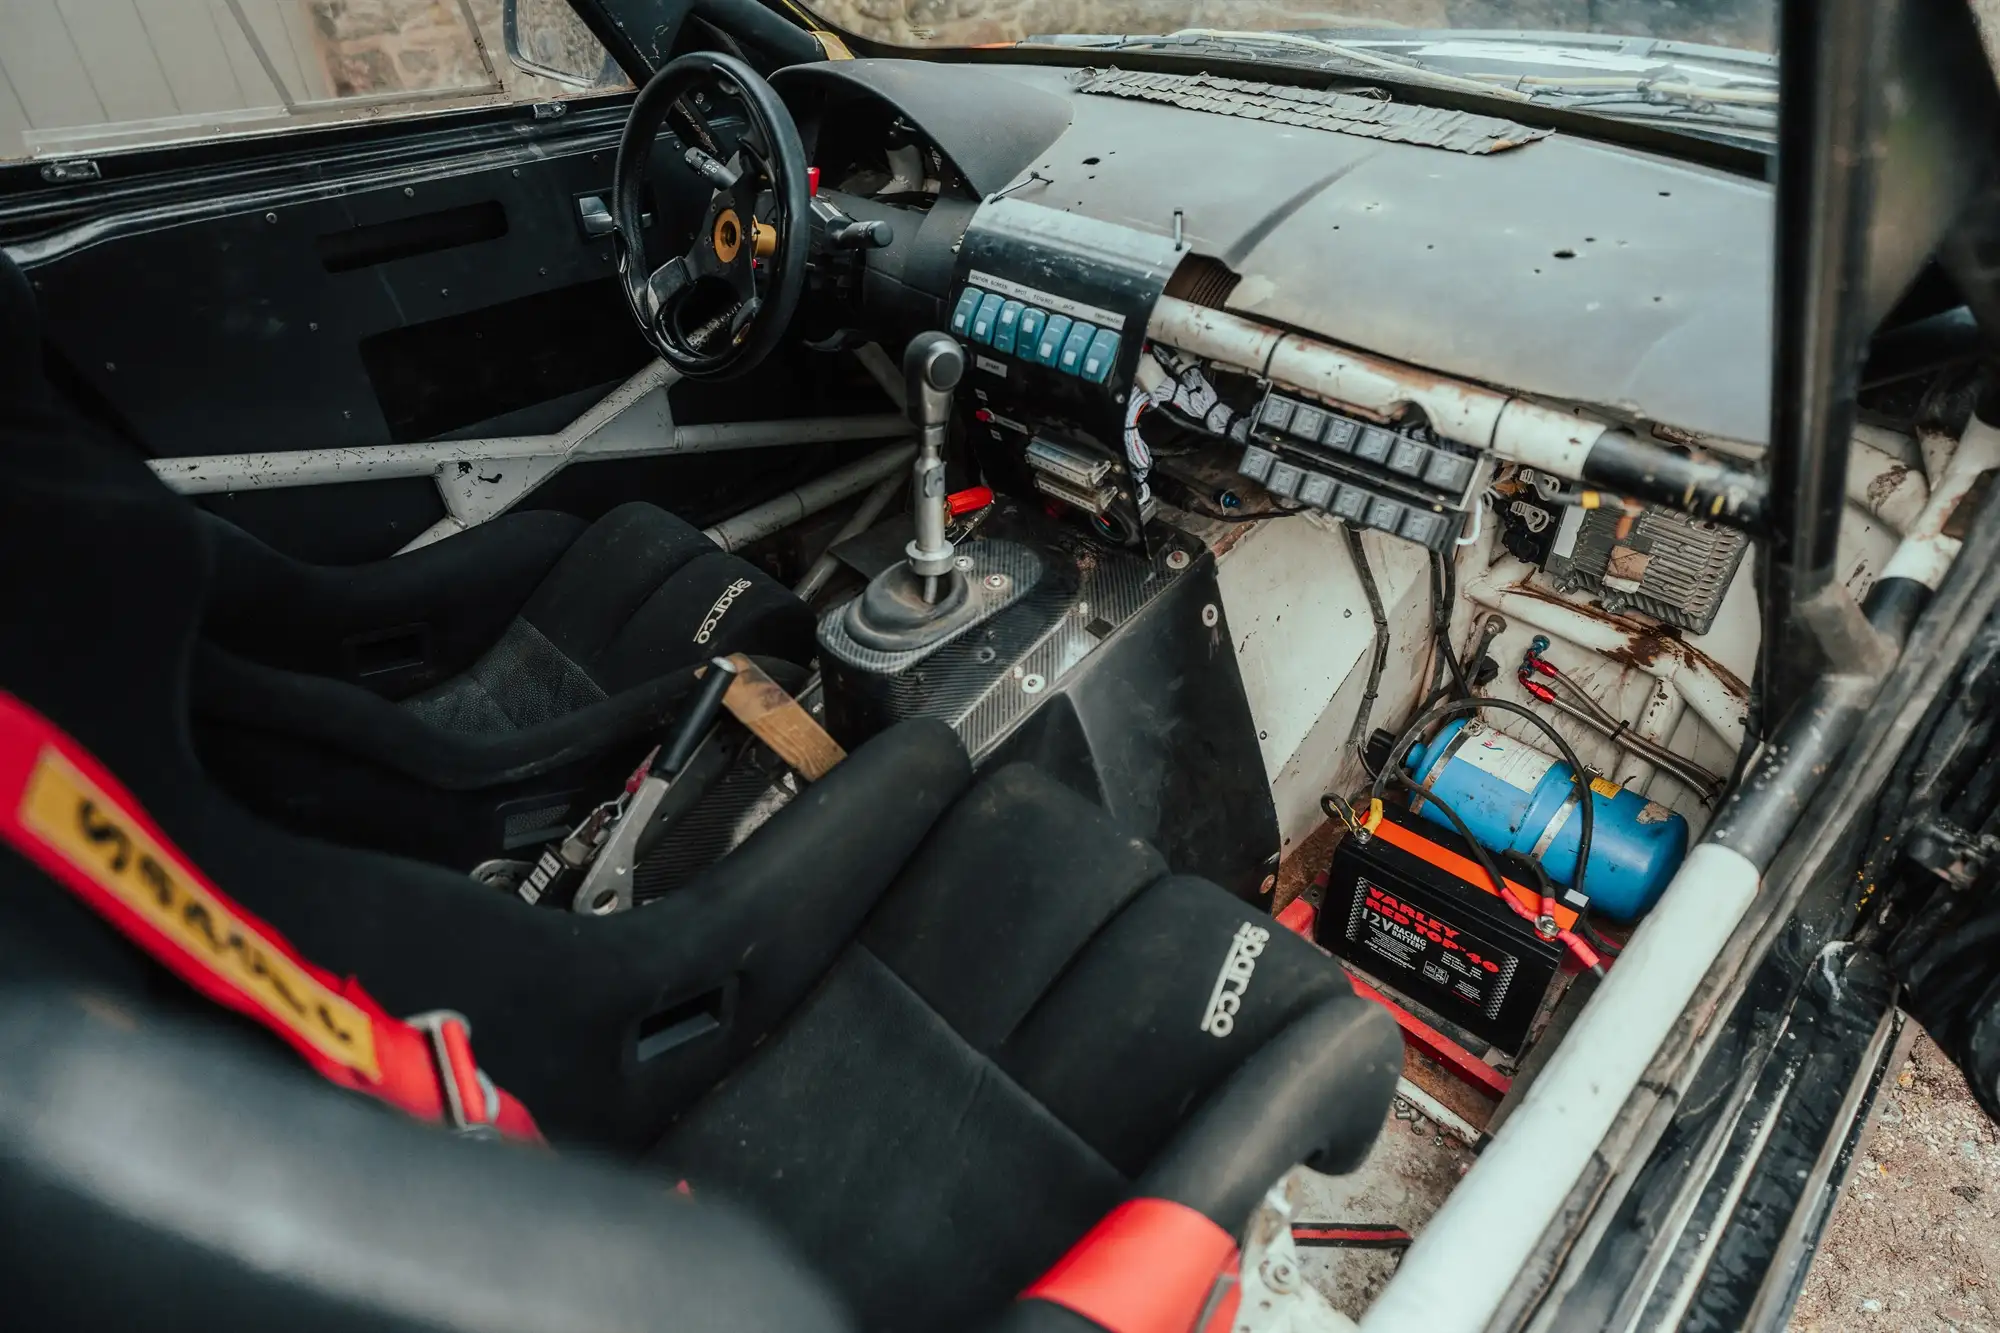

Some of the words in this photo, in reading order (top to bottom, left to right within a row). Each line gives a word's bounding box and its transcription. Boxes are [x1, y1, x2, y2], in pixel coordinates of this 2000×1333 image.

[1361, 907, 1394, 933] 12V
[1369, 886, 1460, 936] VARLEY
[1365, 896, 1410, 926] RED
[1465, 952, 1499, 973] 40
[1391, 929, 1427, 952] BATTERY
[1392, 923, 1427, 947] RACING
